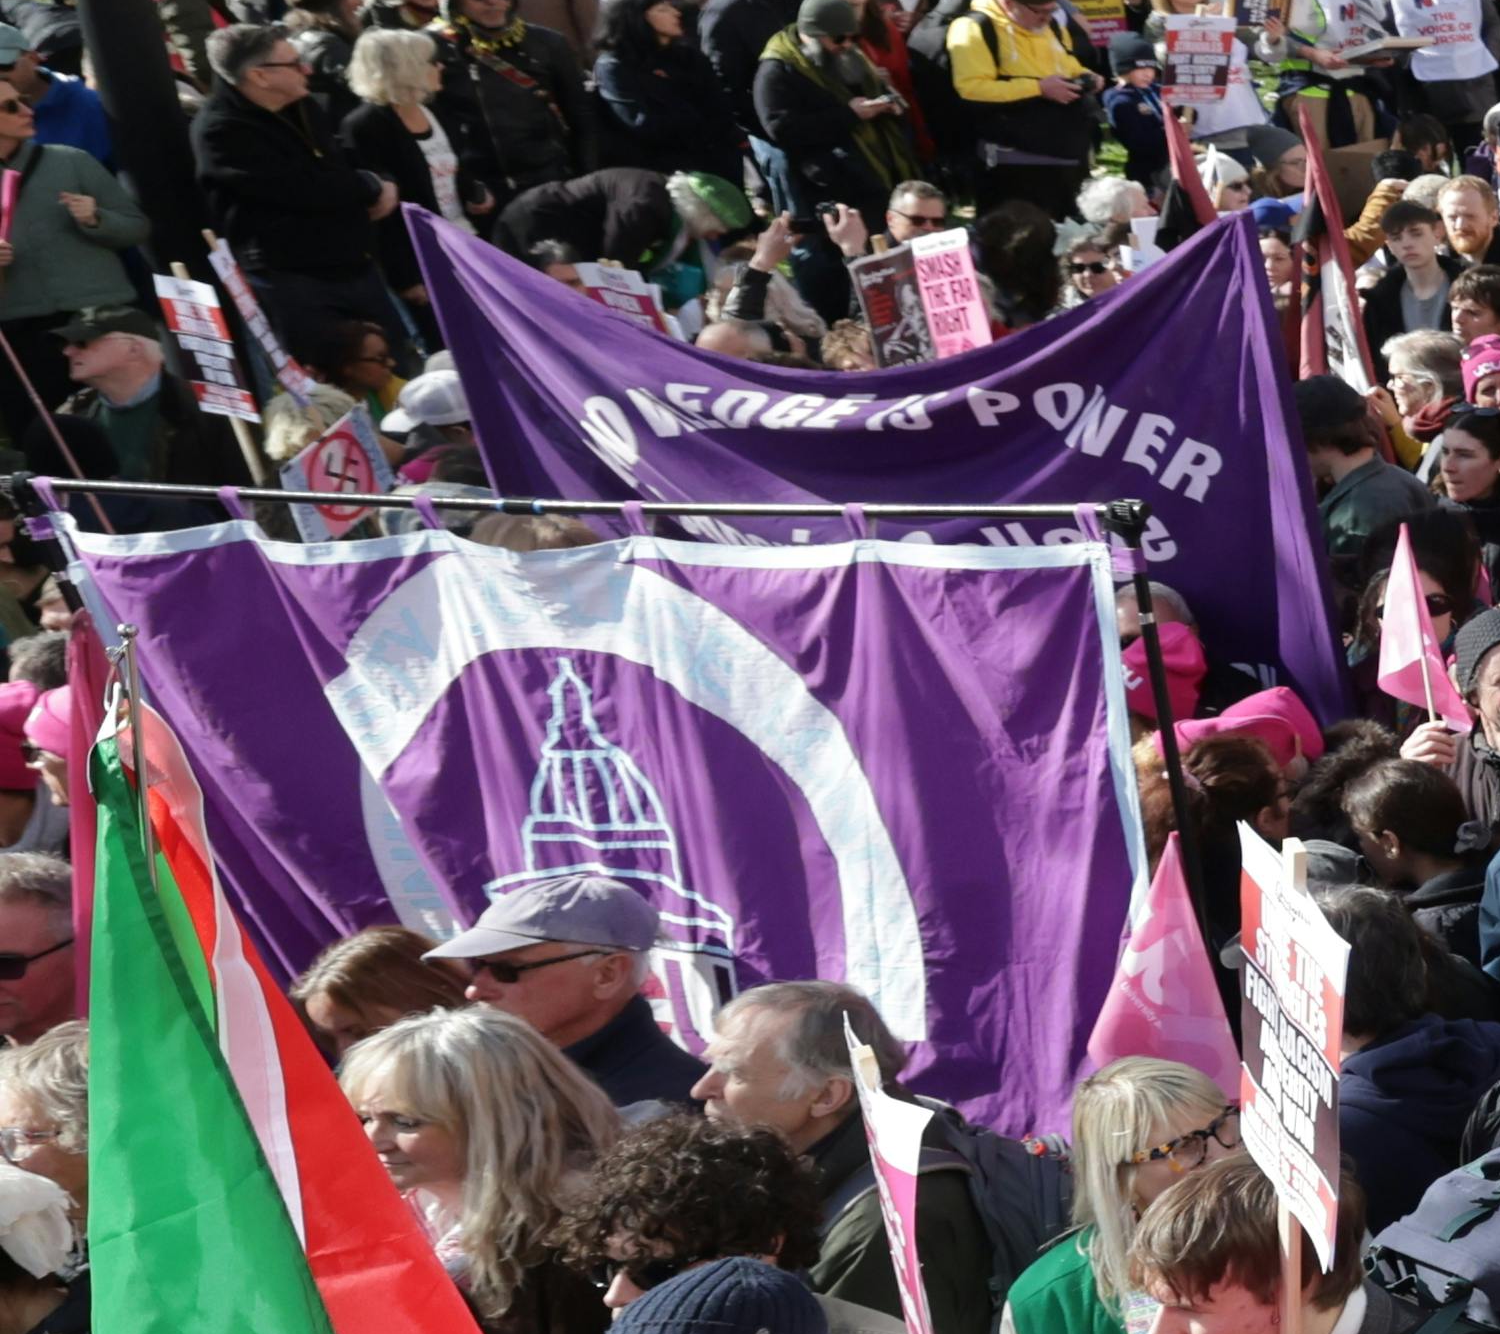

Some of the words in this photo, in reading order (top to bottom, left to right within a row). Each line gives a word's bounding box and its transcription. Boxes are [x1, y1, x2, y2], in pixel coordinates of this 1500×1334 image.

[917, 251, 965, 283] SMASH
[924, 287, 948, 306] THE
[929, 305, 973, 337] RIGHT
